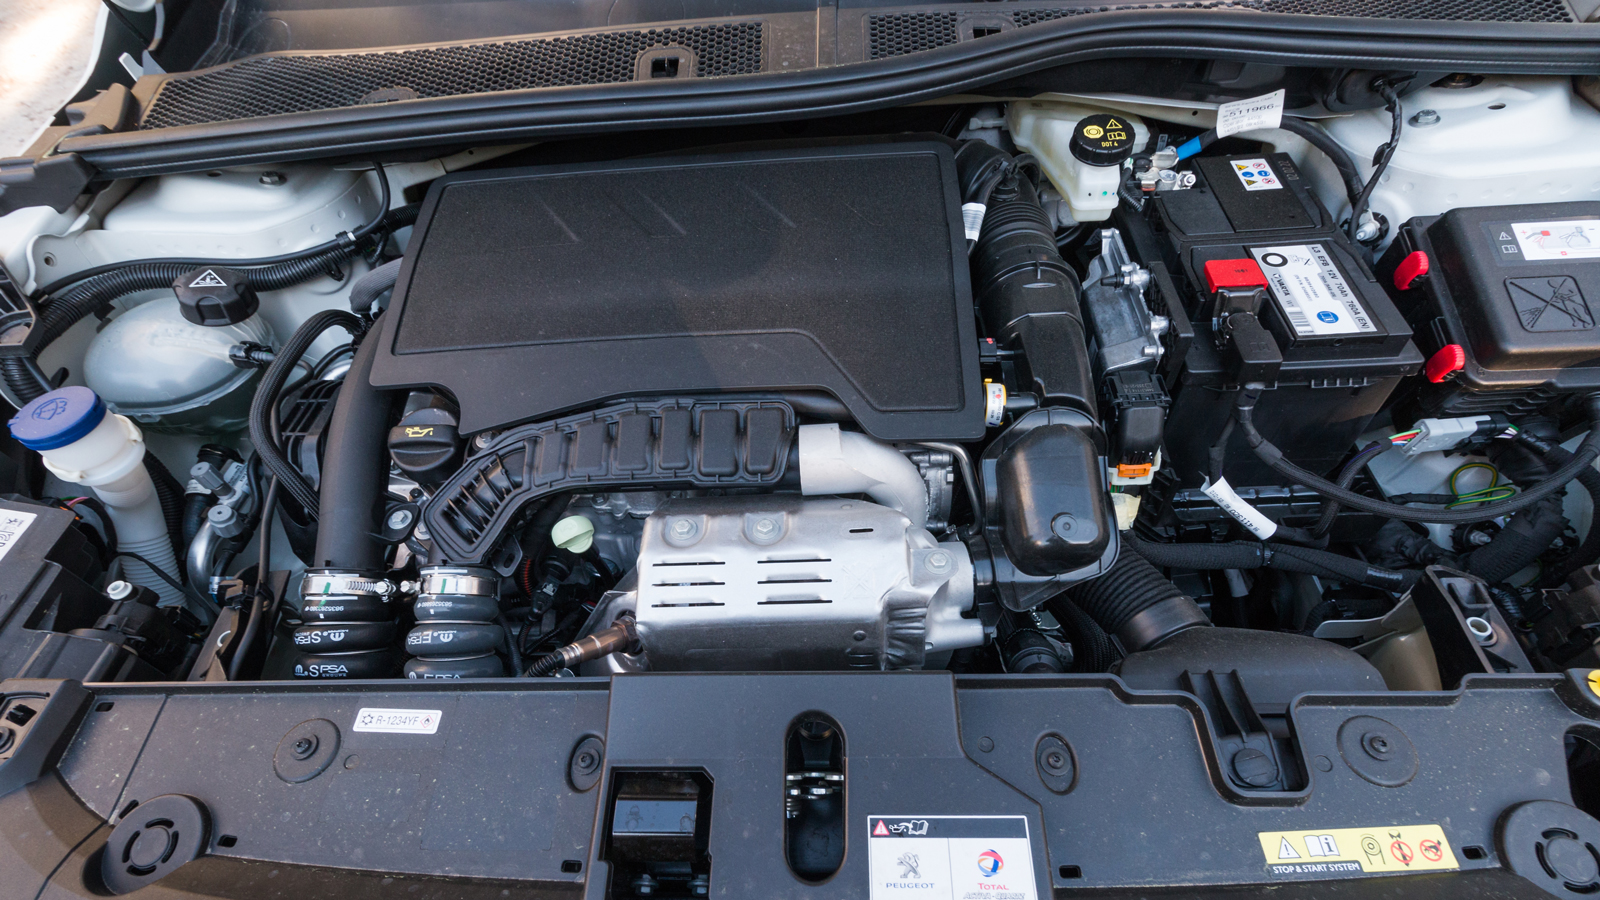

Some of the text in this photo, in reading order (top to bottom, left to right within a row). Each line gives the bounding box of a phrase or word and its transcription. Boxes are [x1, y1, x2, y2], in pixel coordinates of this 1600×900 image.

[1229, 104, 1274, 117] 511966
[1276, 274, 1291, 297] VARTA
[1317, 255, 1330, 267] EFB
[1326, 269, 1339, 280] 12V
[1334, 282, 1349, 297] 70Ah
[1346, 300, 1361, 316] 760A
[1355, 316, 1371, 330] (EN)
[294, 635, 311, 645] PSA
[407, 636, 422, 645] PSA
[320, 664, 348, 673] PSA
[375, 715, 420, 726] R-1234YF
[1273, 863, 1360, 873] STOP & START SYSTEM
[977, 882, 1009, 891] TOTAL
